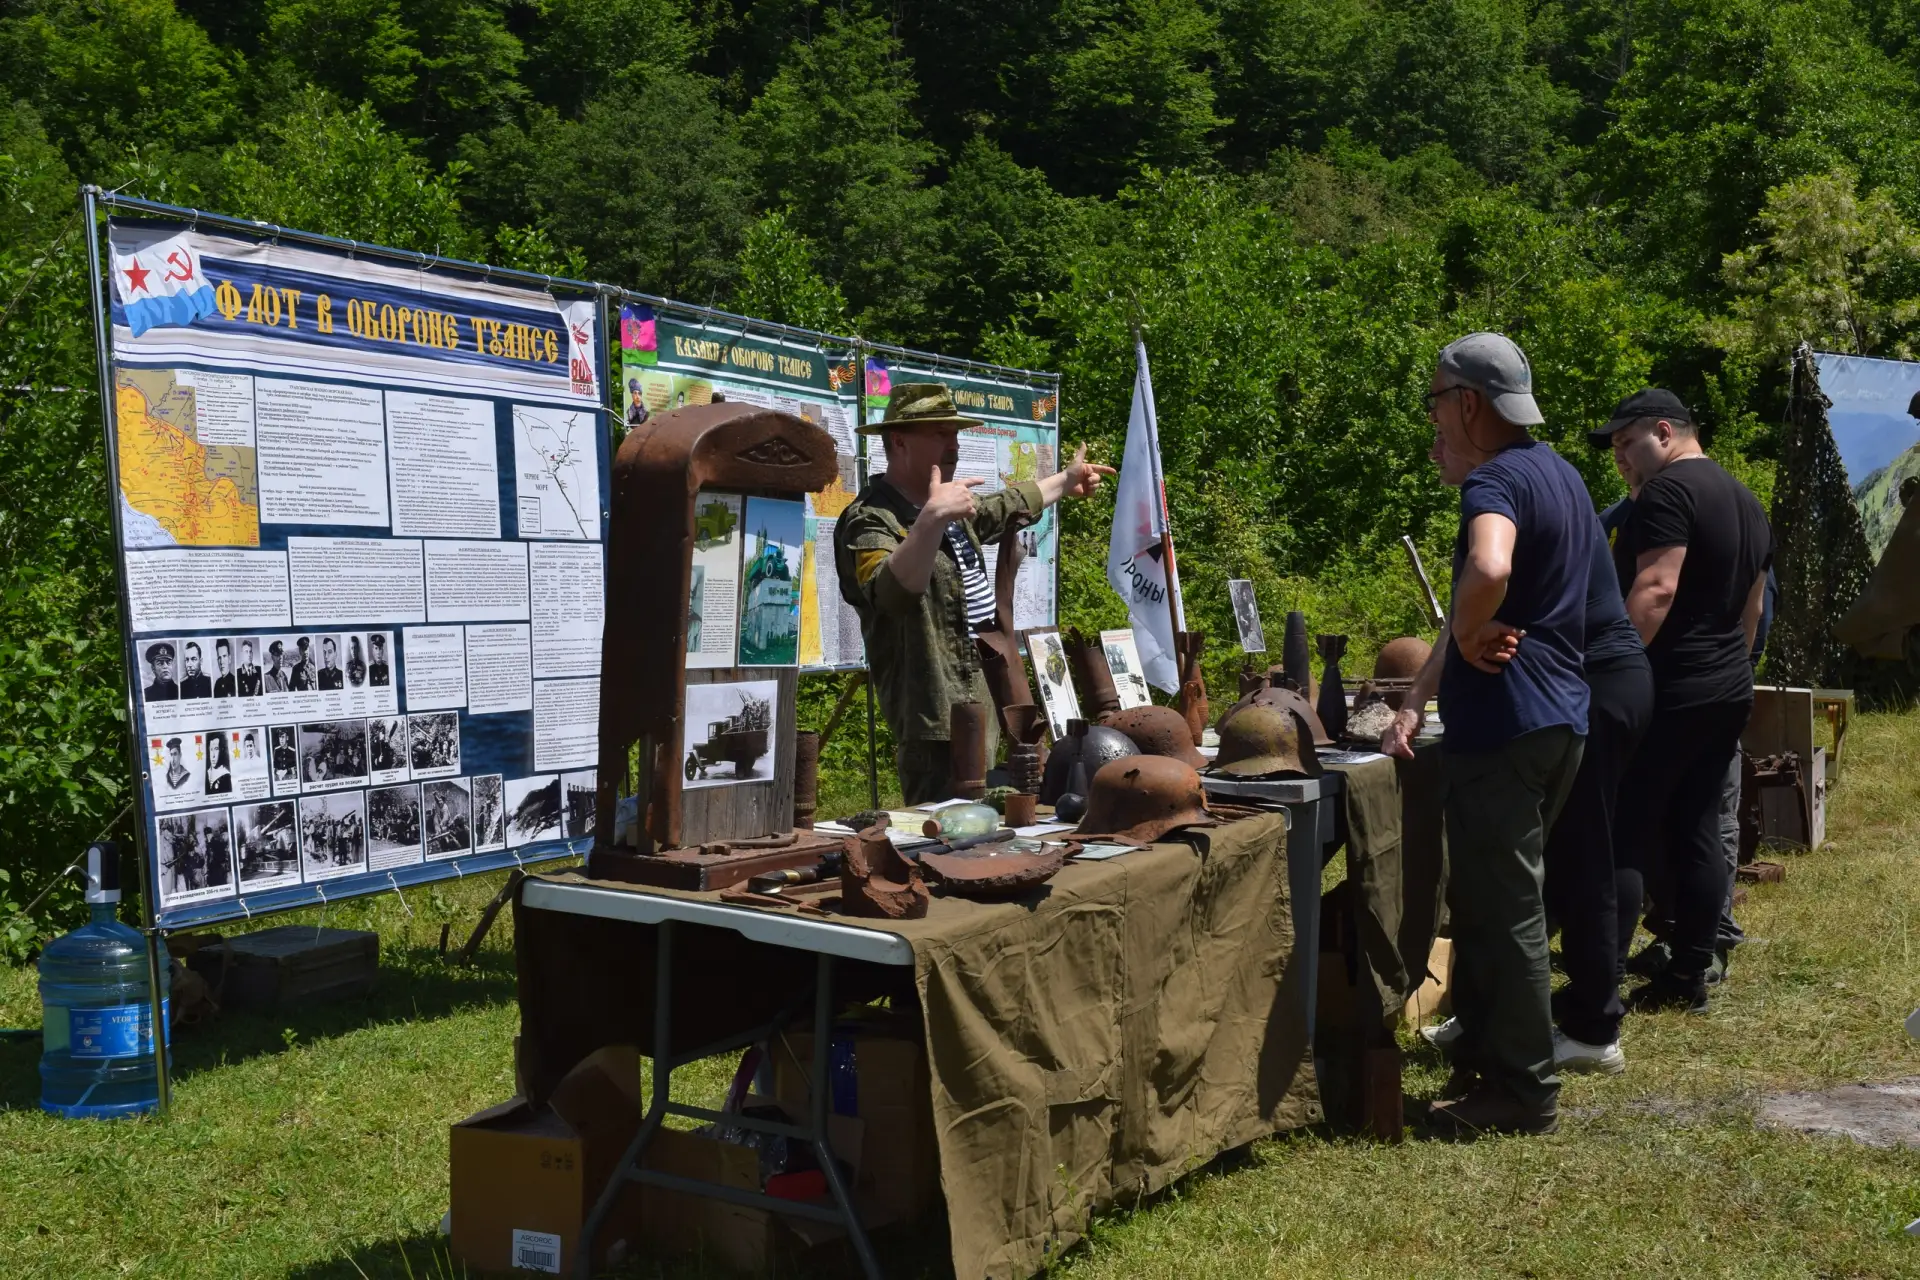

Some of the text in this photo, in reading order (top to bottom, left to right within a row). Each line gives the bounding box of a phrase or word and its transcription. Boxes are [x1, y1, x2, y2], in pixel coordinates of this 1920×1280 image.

[215, 280, 559, 364] ФЛОТ В ОБОРОНЕ ТУАПСЕ
[674, 335, 720, 362] КАЗАКИ
[731, 346, 775, 373] ОБОРОНЕ
[777, 354, 812, 380] ТУАПСЕ
[571, 358, 586, 381] 80
[954, 389, 985, 408] ОБОРОНЕ
[535, 483, 549, 491] МОРЕ
[520, 1234, 553, 1245] ARCOROC
